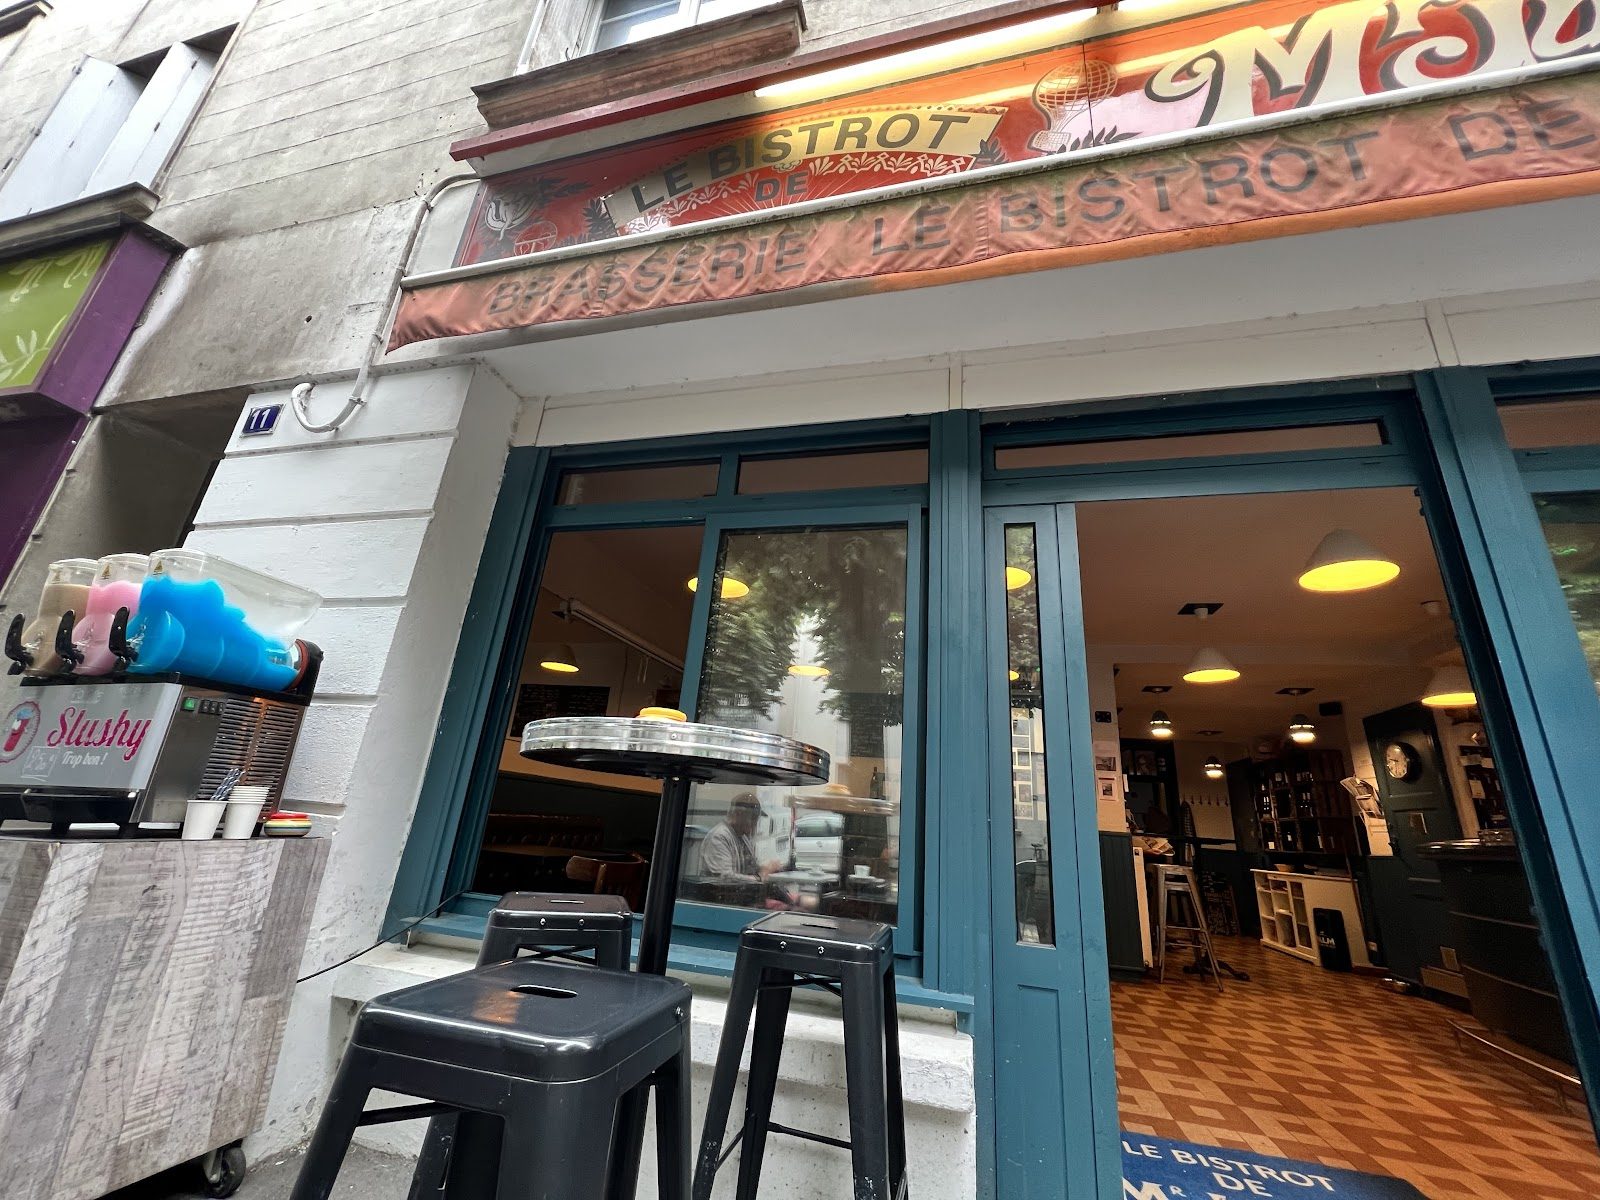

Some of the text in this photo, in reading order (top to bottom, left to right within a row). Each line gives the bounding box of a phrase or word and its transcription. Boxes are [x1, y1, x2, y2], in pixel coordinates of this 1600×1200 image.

[630, 113, 971, 213] LE BISTROT
[488, 97, 1597, 315] BRASSERIE LE BISTROT DE
[755, 171, 809, 202] DE
[249, 408, 272, 430] 11
[47, 706, 152, 761] Slushy
[62, 751, 83, 768] Trop
[1121, 1141, 1336, 1193] LE BISTROT
[1212, 1172, 1273, 1198] DE
